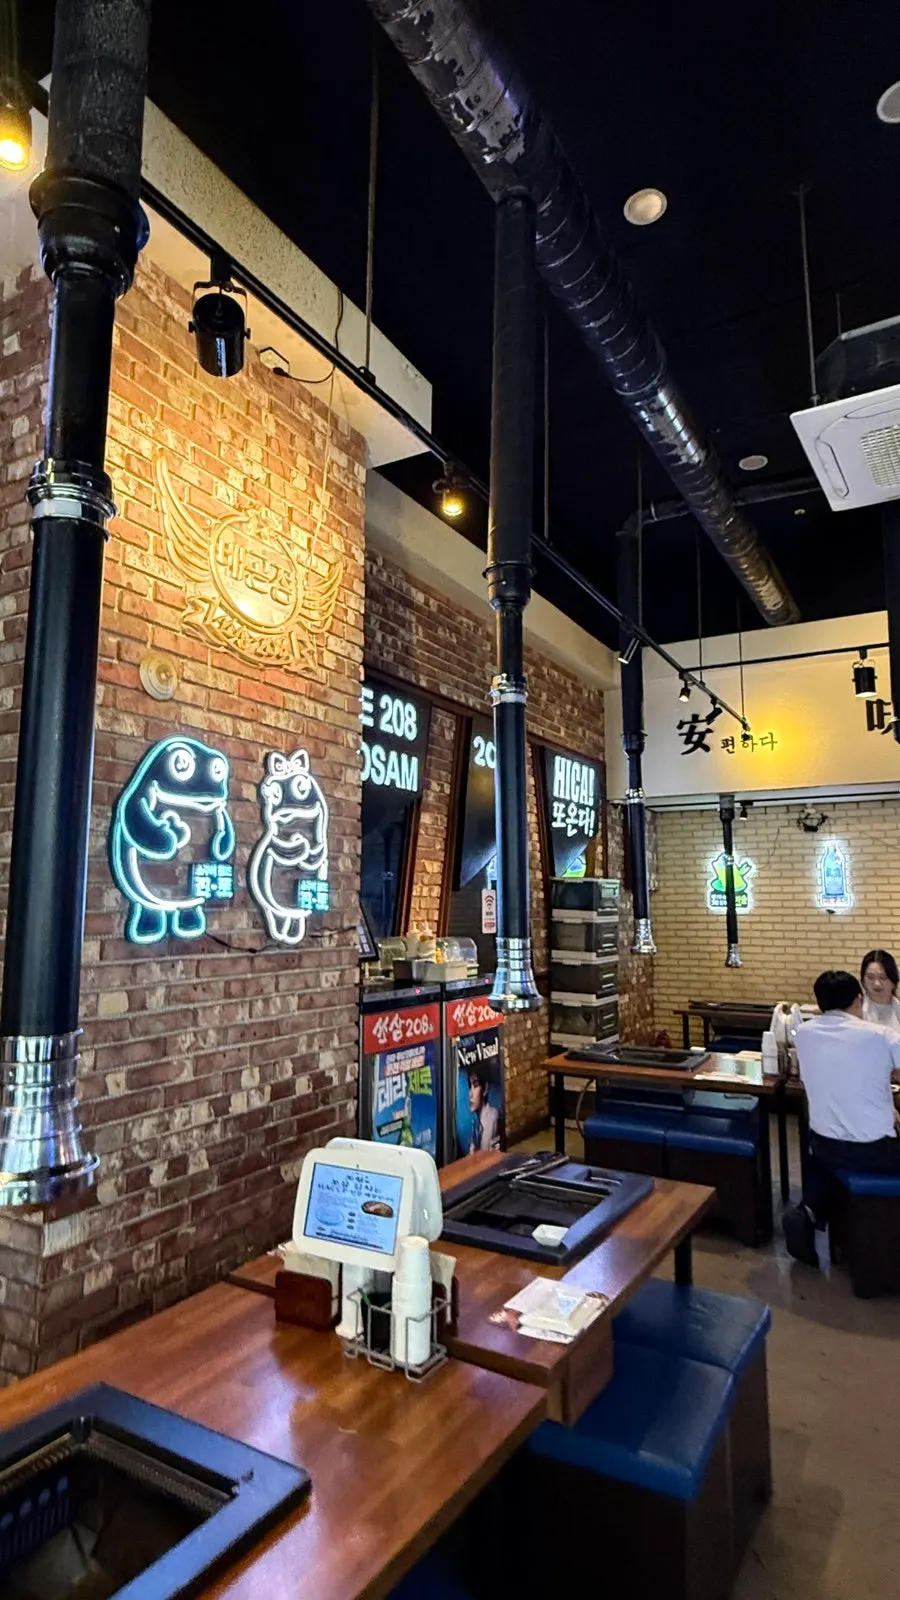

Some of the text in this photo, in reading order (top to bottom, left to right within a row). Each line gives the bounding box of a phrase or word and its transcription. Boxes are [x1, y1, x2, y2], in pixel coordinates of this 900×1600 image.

[379, 694, 418, 741] 208
[676, 713, 714, 756] 安
[720, 732, 778, 754] 편하다
[553, 755, 595, 806] HICA!
[456, 1046, 477, 1067] New
[476, 1036, 499, 1061] Visual
